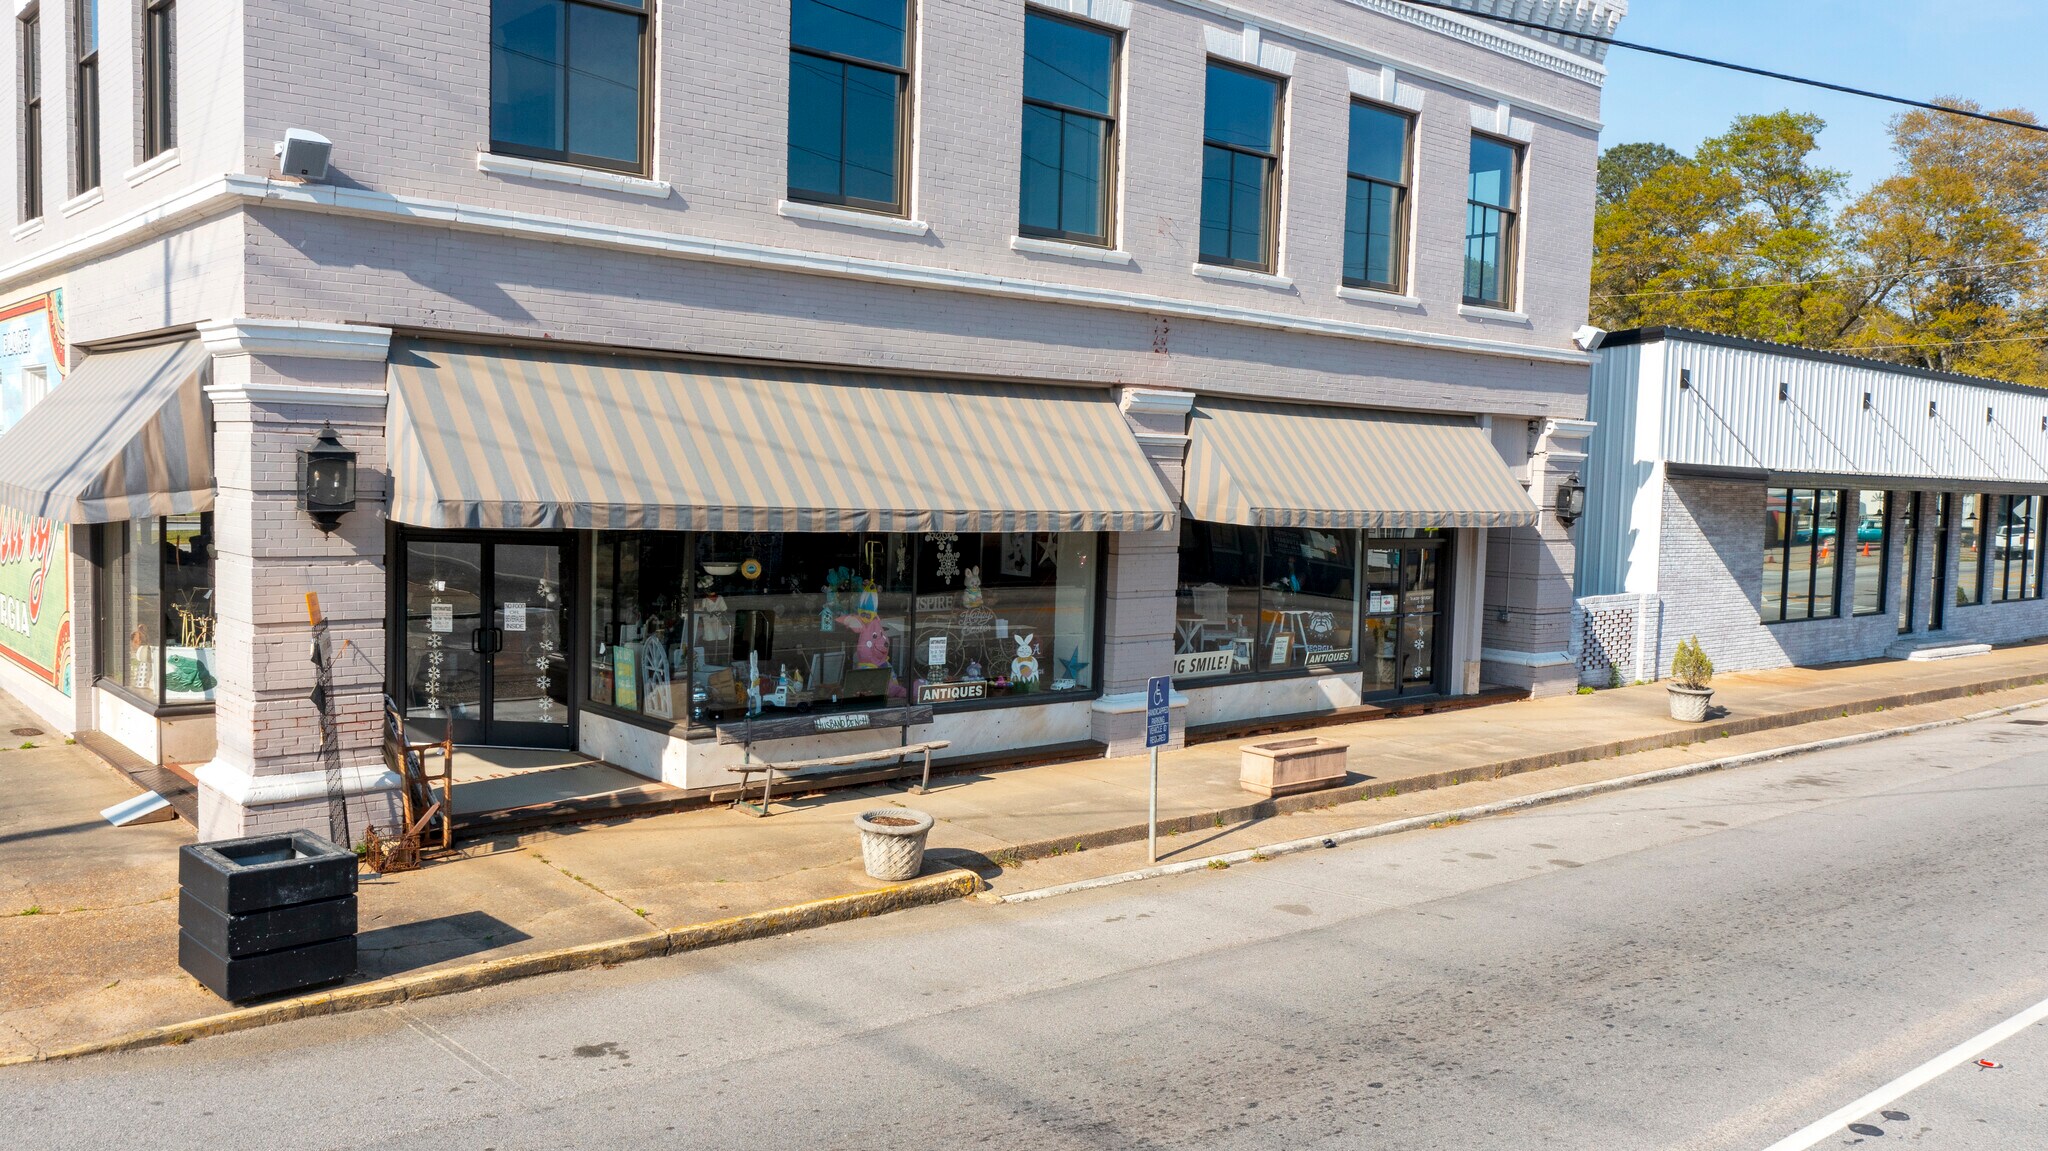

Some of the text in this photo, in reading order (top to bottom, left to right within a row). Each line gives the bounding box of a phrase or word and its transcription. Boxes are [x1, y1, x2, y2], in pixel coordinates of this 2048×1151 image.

[958, 608, 993, 625] Happy
[1189, 655, 1229, 673] SMILE!
[1309, 652, 1349, 664] ANTIQUES
[923, 685, 983, 701] ANTIQUES
